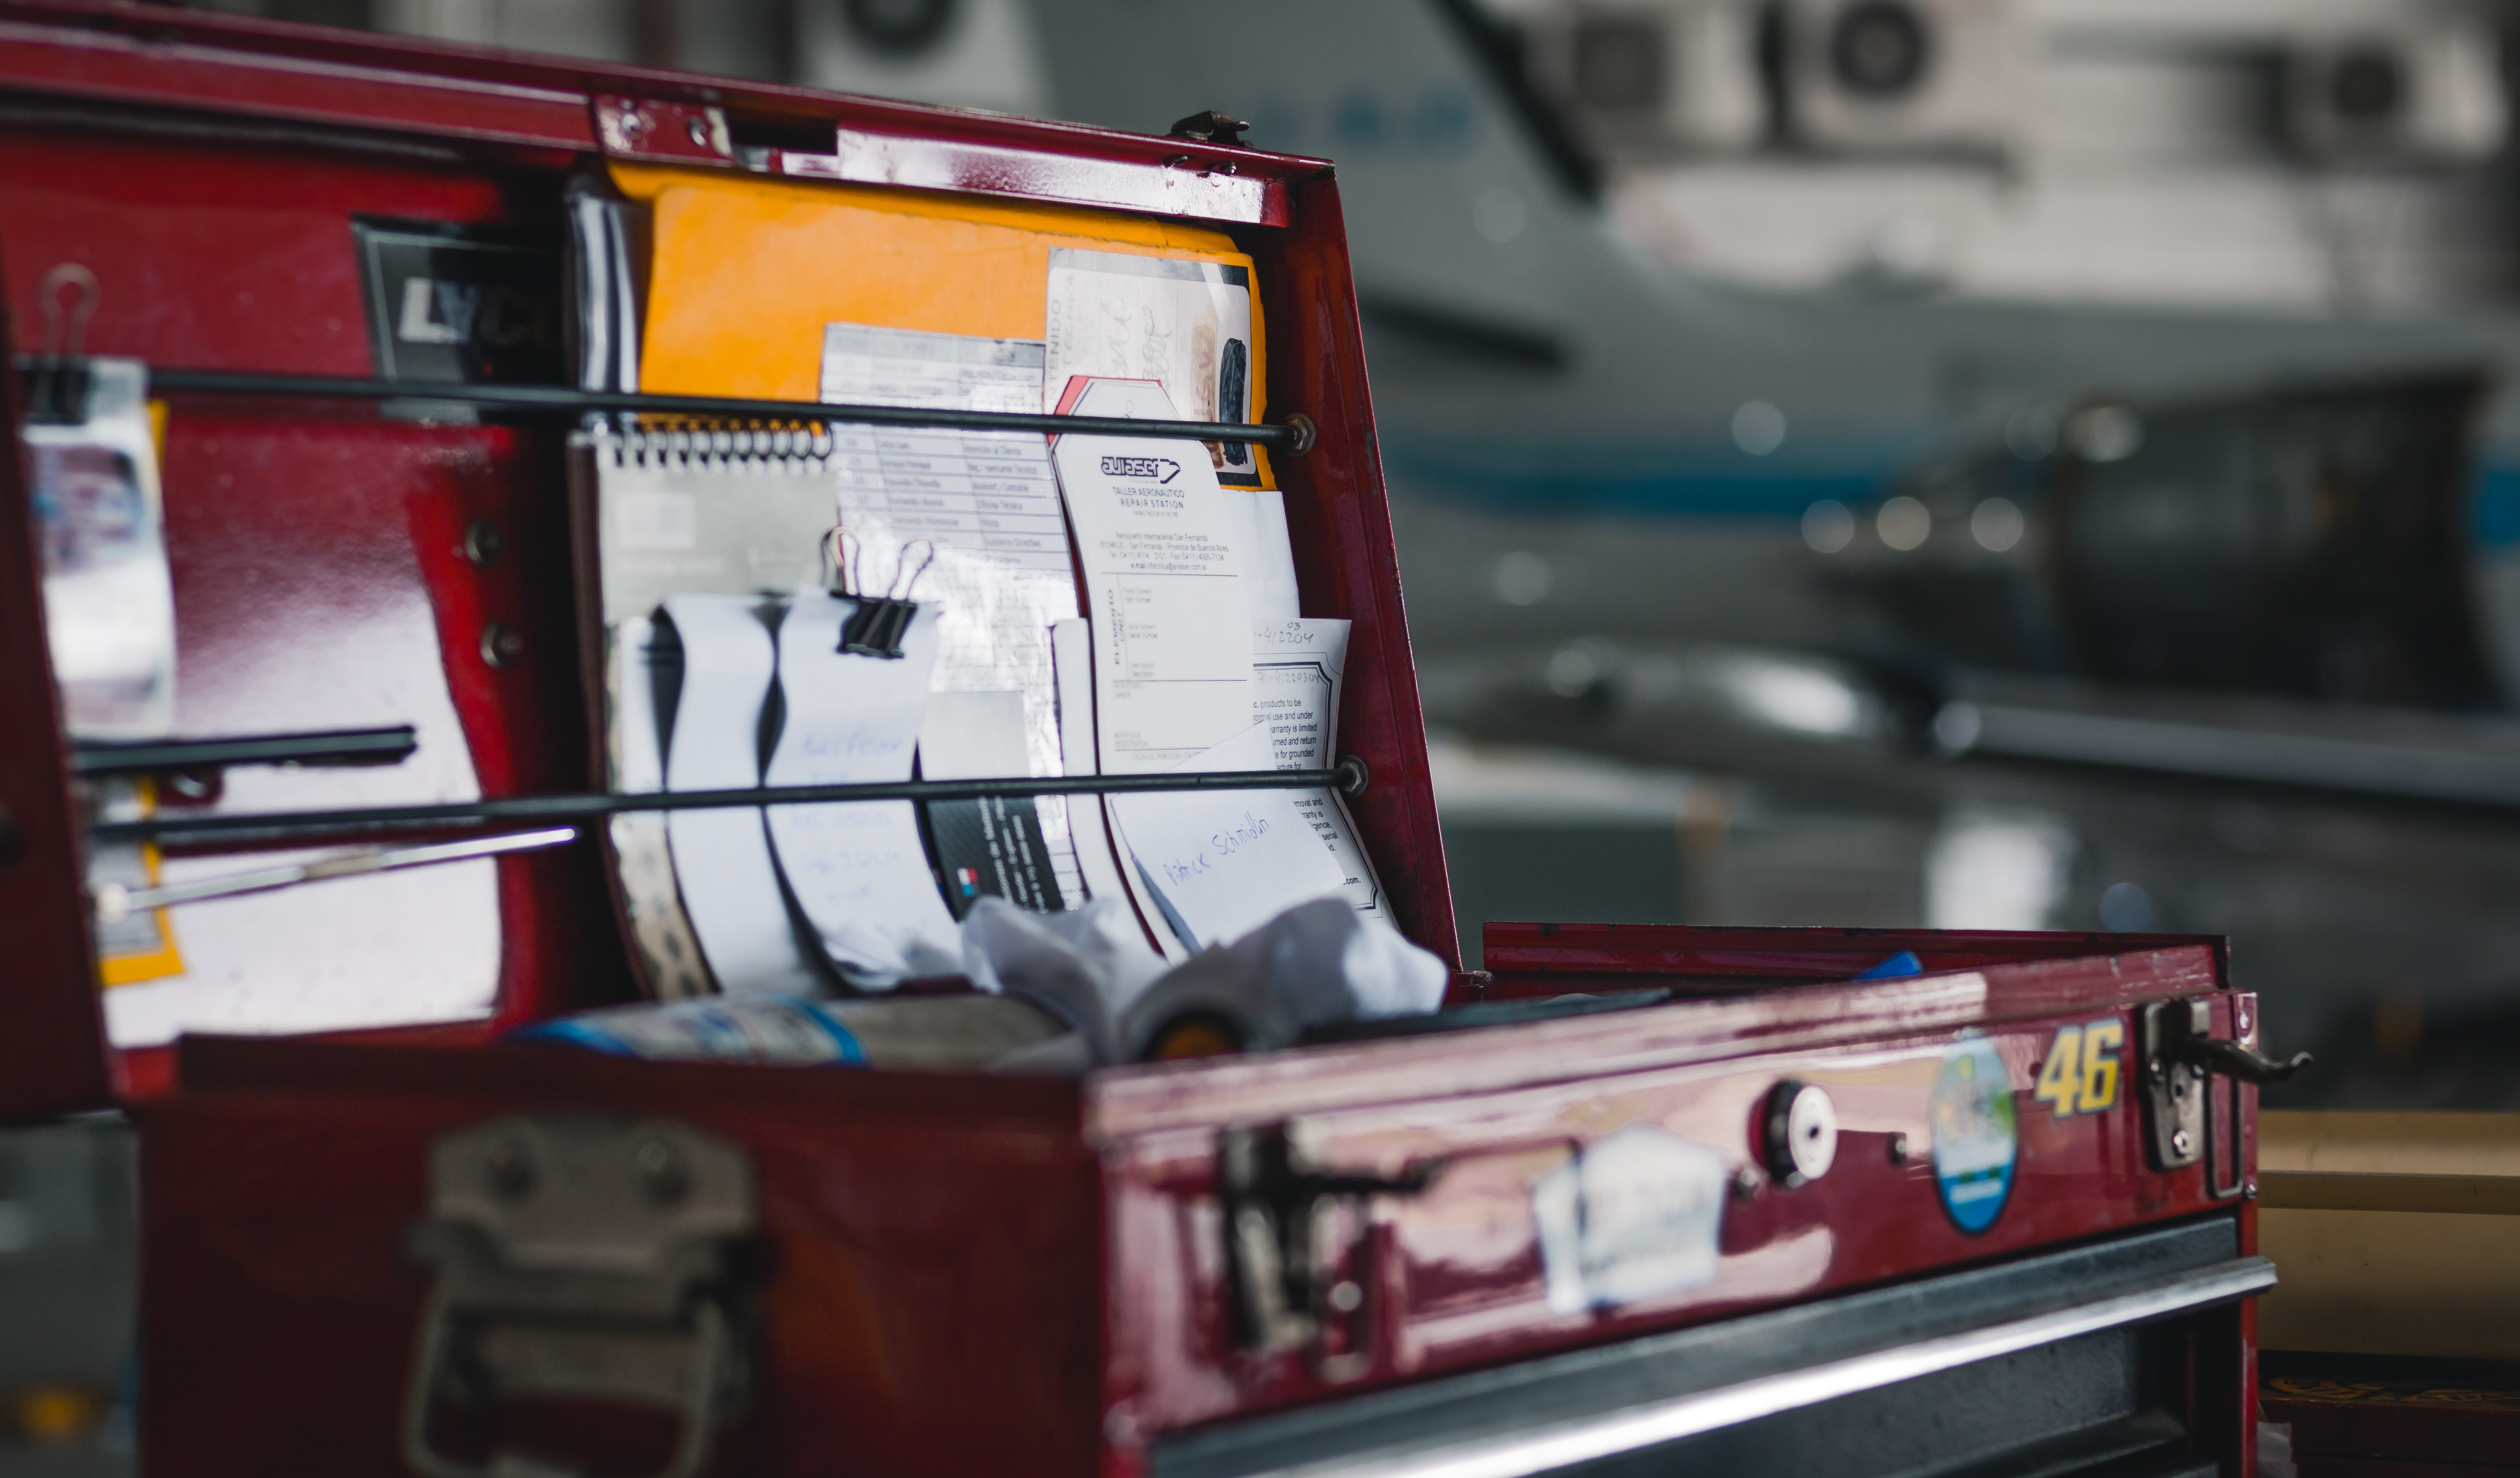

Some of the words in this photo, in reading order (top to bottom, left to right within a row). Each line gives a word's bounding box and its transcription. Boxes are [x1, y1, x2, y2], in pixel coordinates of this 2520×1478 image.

[1113, 486, 1137, 496] TALLER
[1139, 488, 1185, 498] AERONAUTICO
[1120, 498, 1149, 507] REPAIR
[1150, 499, 1184, 509] STATION
[1260, 699, 1286, 710] products
[1287, 698, 1293, 707] to
[1294, 698, 1301, 707] be
[1285, 711, 1295, 720] and
[1297, 710, 1313, 719] under
[1271, 725, 1291, 735] arranty
[1293, 723, 1297, 732] is
[1299, 723, 1317, 732] limited
[1288, 736, 1299, 745] and
[1300, 736, 1317, 745] return
[1289, 748, 1314, 760] grounded
[1312, 797, 1323, 806] and
[1322, 831, 1339, 841] serial
[2034, 1016, 2124, 1118] 46
